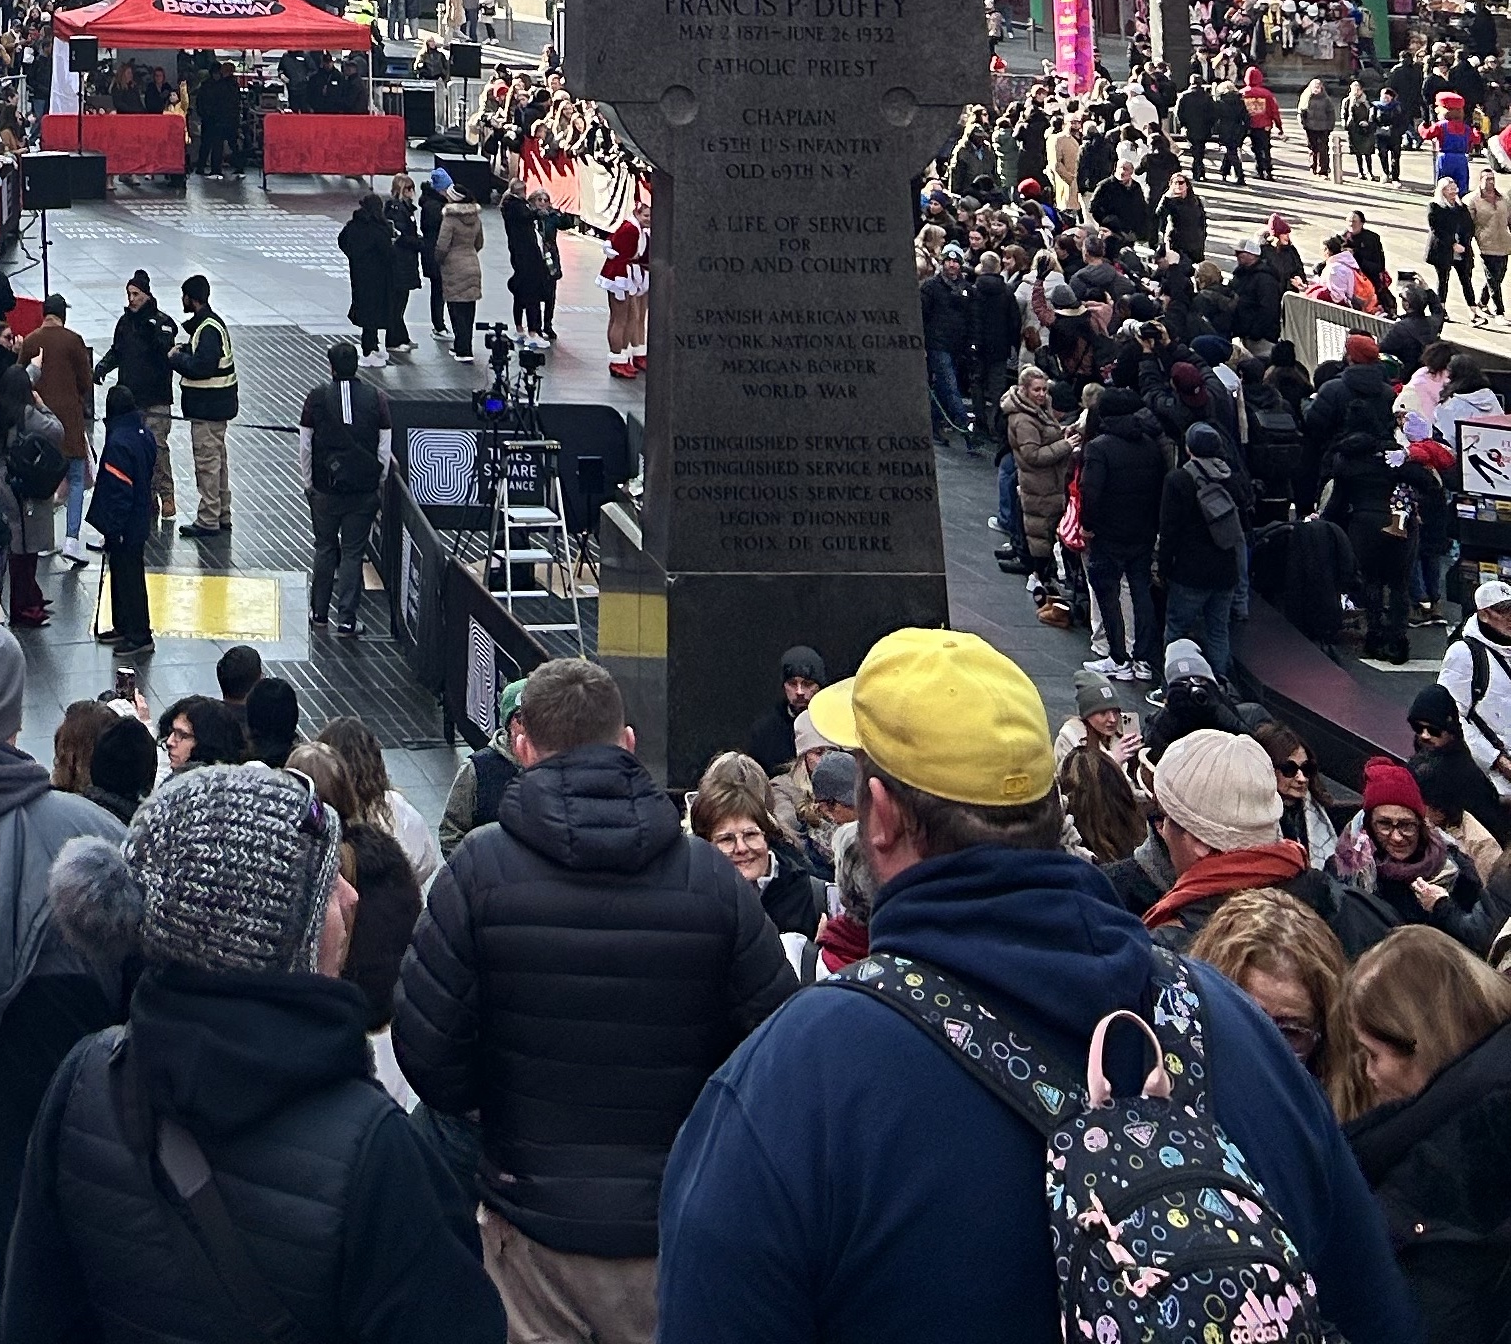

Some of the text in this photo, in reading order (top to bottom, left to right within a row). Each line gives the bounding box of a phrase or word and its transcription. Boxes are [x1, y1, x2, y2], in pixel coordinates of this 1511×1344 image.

[678, 25, 895, 43] MAY 26 1932
[697, 57, 878, 77] CATHOLIC PRIEST
[742, 108, 836, 127] CHAPLAIN
[798, 138, 883, 154] INFANTRY
[725, 163, 765, 179] OLD
[728, 216, 887, 233] LIFE OF SERVICE
[778, 238, 811, 252] FOR
[698, 258, 893, 274] GOD AND COUNTRY
[696, 309, 900, 325] SPANISH AMERICAN WAR
[674, 334, 924, 350] NEW YORK NATIONAL GUARD
[721, 360, 877, 375] MEXICAN BORDER
[742, 384, 858, 399] WORLD WAR
[673, 435, 931, 451] DISTINGUISHED SERVICE CROSS
[674, 460, 936, 478] DISTINGUISHED SERVICE MEDAL
[674, 486, 934, 502] CONSPICUOUS SERVICE CROSS
[720, 511, 782, 526] LEGION
[720, 535, 893, 552] CROIX DE GUERRE
[1230, 1324, 1279, 1344] adidas
